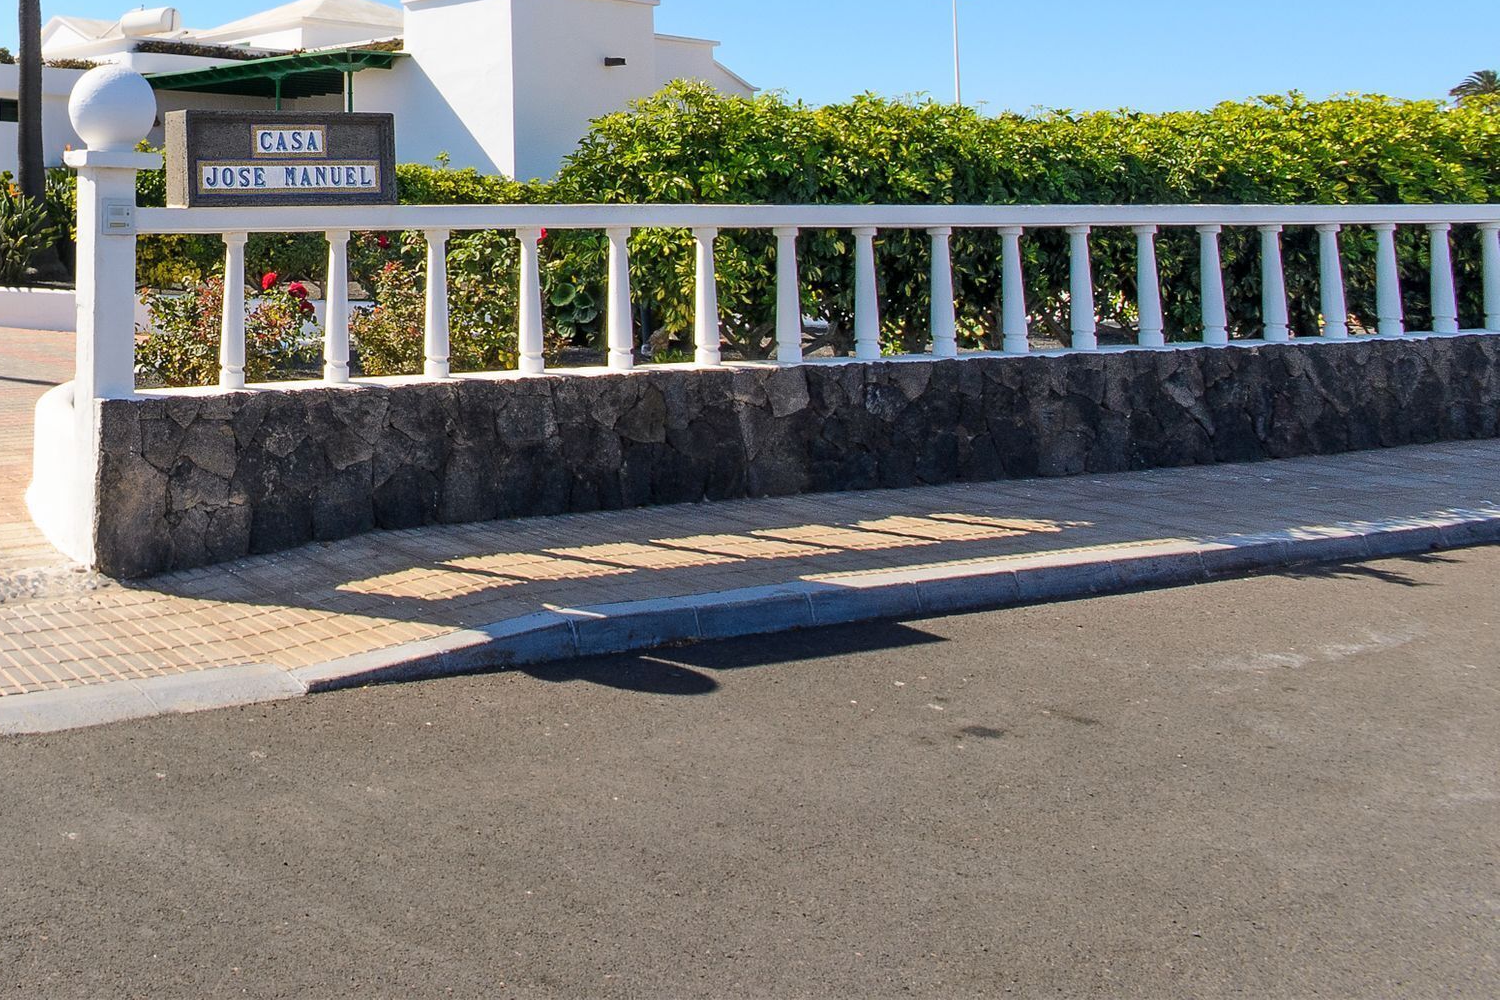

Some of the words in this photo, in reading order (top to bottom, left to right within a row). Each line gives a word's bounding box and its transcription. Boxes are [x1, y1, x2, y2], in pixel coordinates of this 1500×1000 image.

[260, 131, 318, 151] CASA
[206, 167, 266, 187] JOSE
[284, 166, 372, 187] MANUEL
